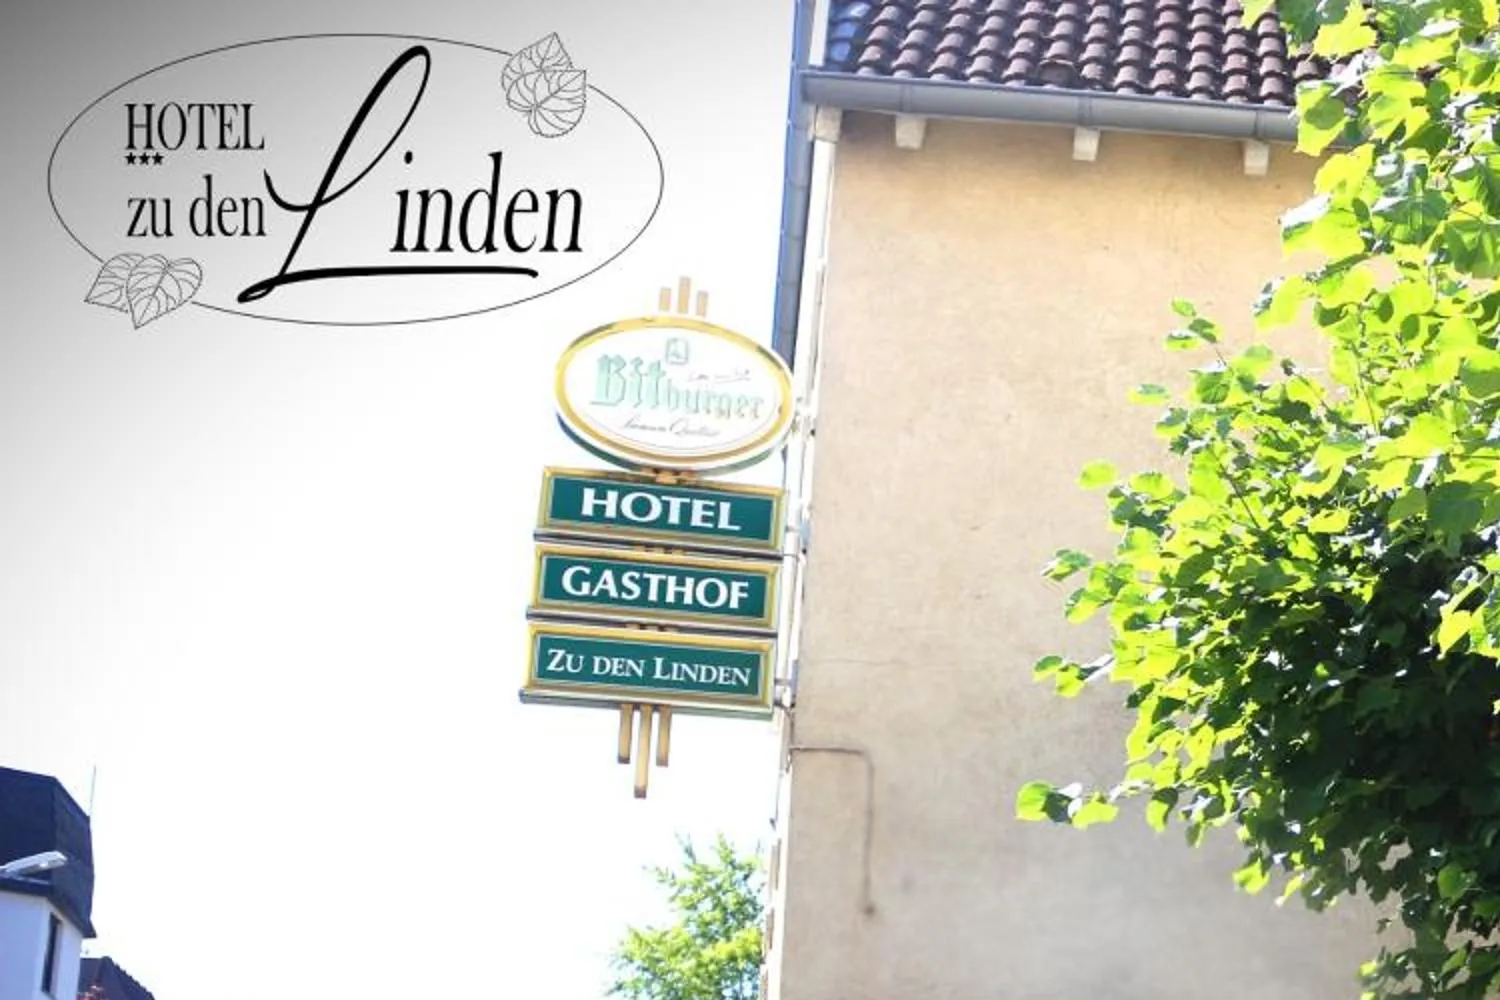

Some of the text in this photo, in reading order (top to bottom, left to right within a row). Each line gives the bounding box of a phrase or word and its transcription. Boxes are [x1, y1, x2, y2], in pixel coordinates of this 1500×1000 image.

[589, 352, 765, 421] Bitburger
[579, 486, 742, 533] HOTEL
[561, 565, 750, 610] GASTHOF
[547, 648, 751, 688] ZU DEN LINDEN
